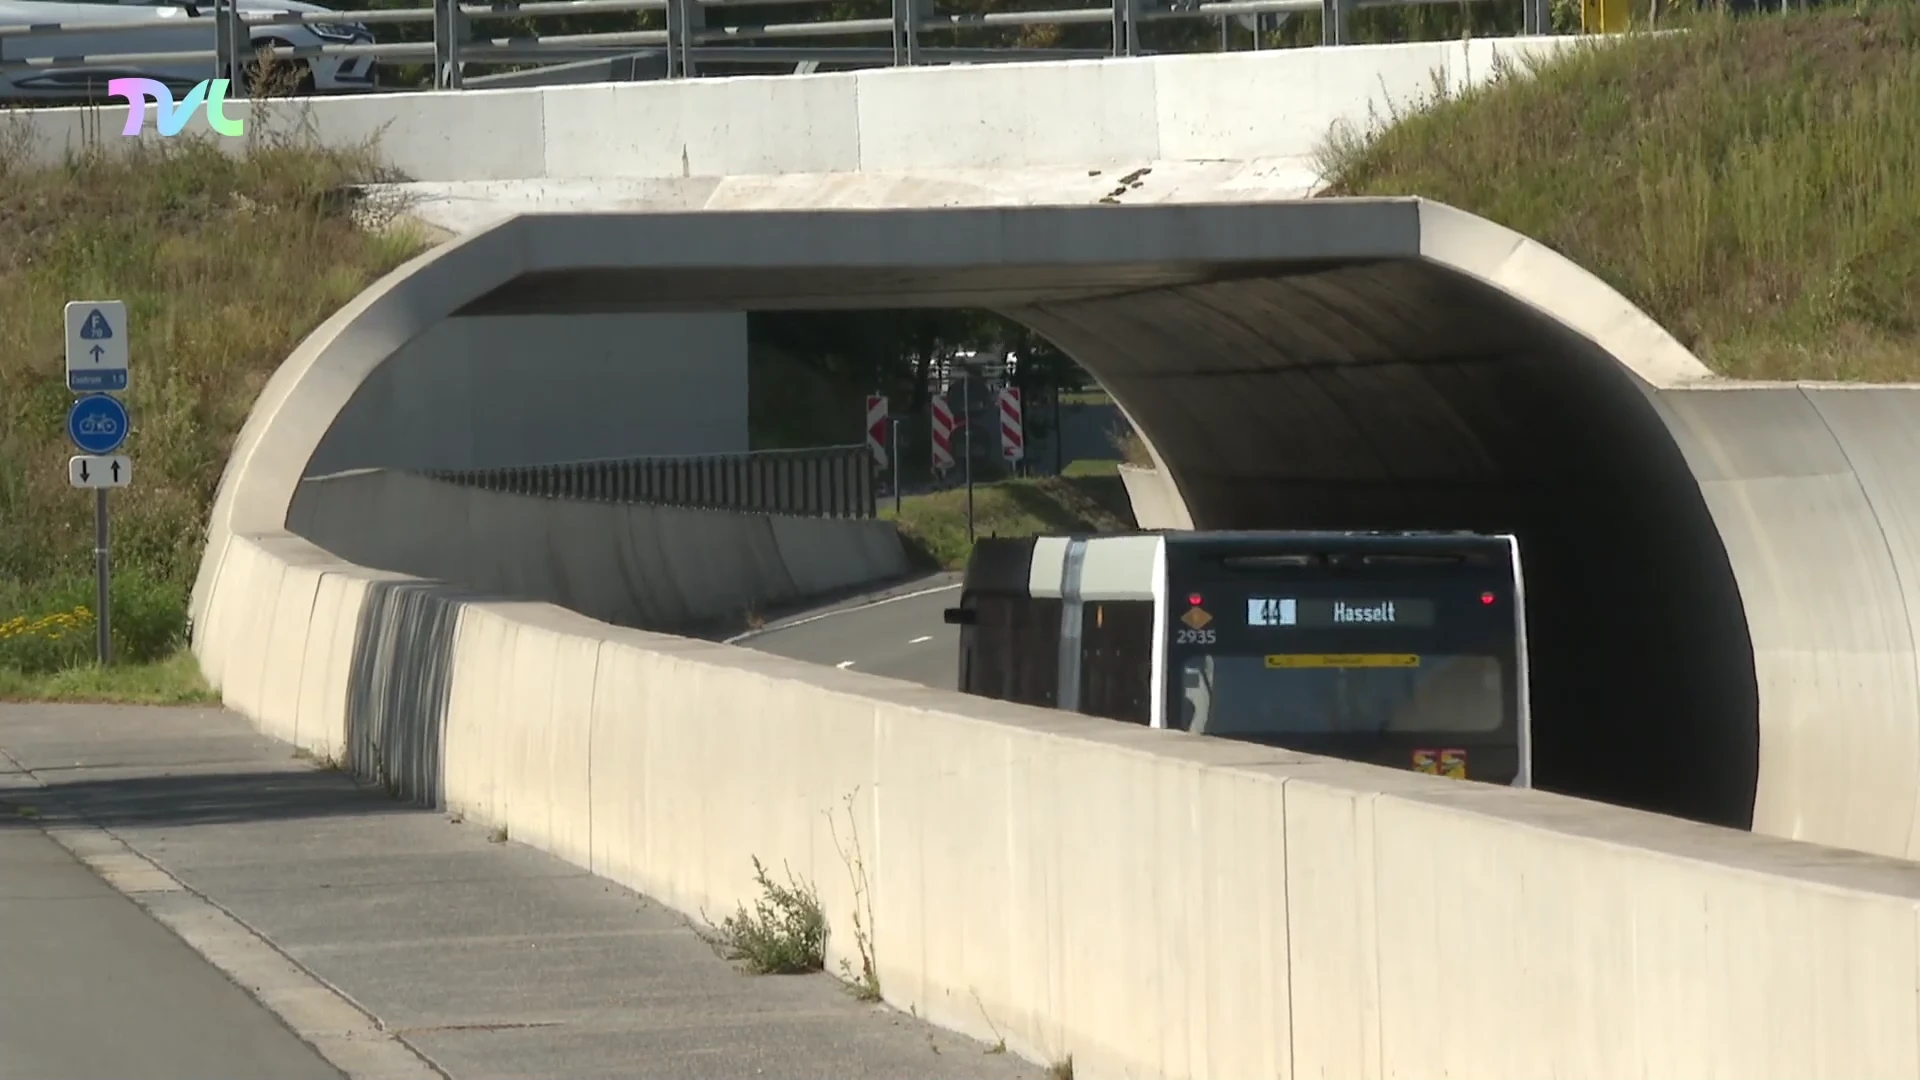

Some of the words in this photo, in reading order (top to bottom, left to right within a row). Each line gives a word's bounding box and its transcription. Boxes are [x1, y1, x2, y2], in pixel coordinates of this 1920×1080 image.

[92, 315, 100, 328] F
[1262, 599, 1281, 625] 44
[1334, 601, 1395, 623] Hasselt
[1176, 629, 1217, 644] 2935
